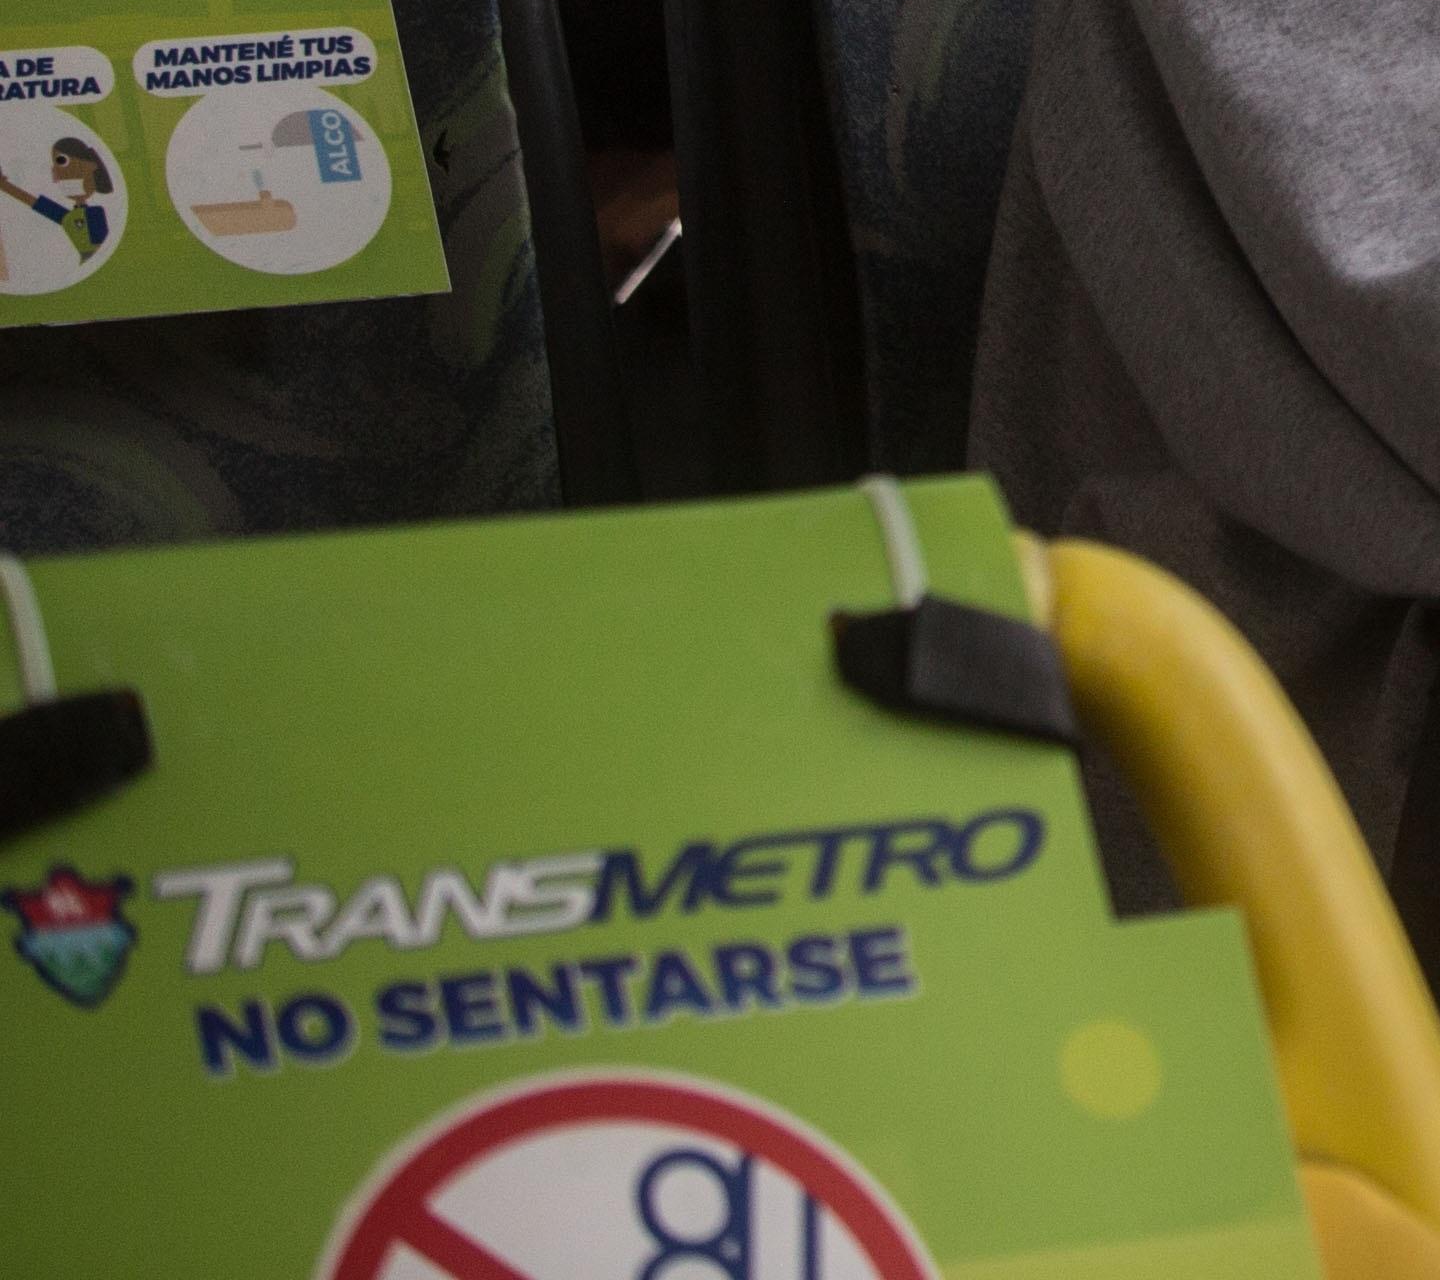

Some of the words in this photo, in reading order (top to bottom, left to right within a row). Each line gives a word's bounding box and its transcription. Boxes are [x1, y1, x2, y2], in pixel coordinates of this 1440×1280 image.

[16, 57, 54, 77] DE
[154, 36, 294, 67] MANTENÉ
[300, 35, 354, 55] TUS
[0, 76, 101, 101] ATURA
[147, 62, 252, 90] MANOS
[257, 57, 371, 82] LIMPIAS
[321, 111, 352, 175] ALCO
[195, 990, 355, 1078] NO
[376, 929, 913, 1052] SENTARSE
